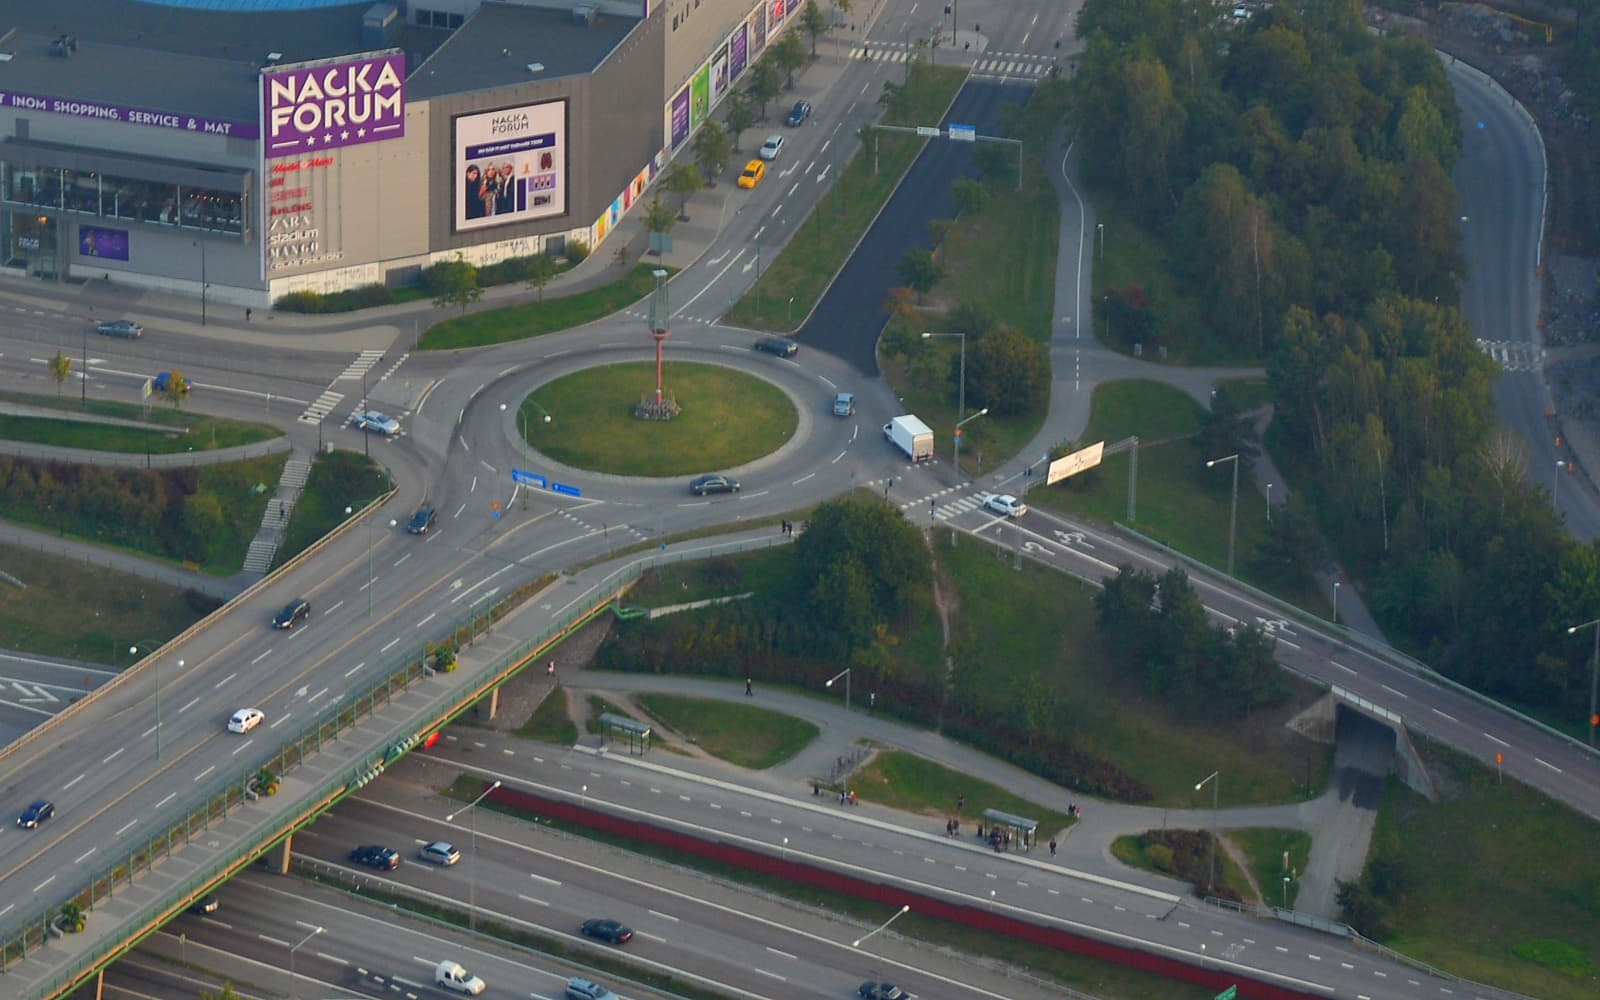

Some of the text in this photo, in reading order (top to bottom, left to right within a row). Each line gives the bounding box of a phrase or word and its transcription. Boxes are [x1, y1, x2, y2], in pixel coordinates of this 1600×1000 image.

[270, 60, 401, 107] NACKA
[12, 95, 47, 112] INOM
[128, 110, 180, 129] SERVICE
[187, 118, 197, 130] &
[204, 120, 232, 135] MAT
[271, 87, 402, 137] FORUM
[492, 113, 529, 126] NACKA
[492, 122, 529, 134] FORUM
[271, 215, 310, 231] ZARA
[270, 228, 319, 245] stadium
[270, 240, 319, 258] MANGO
